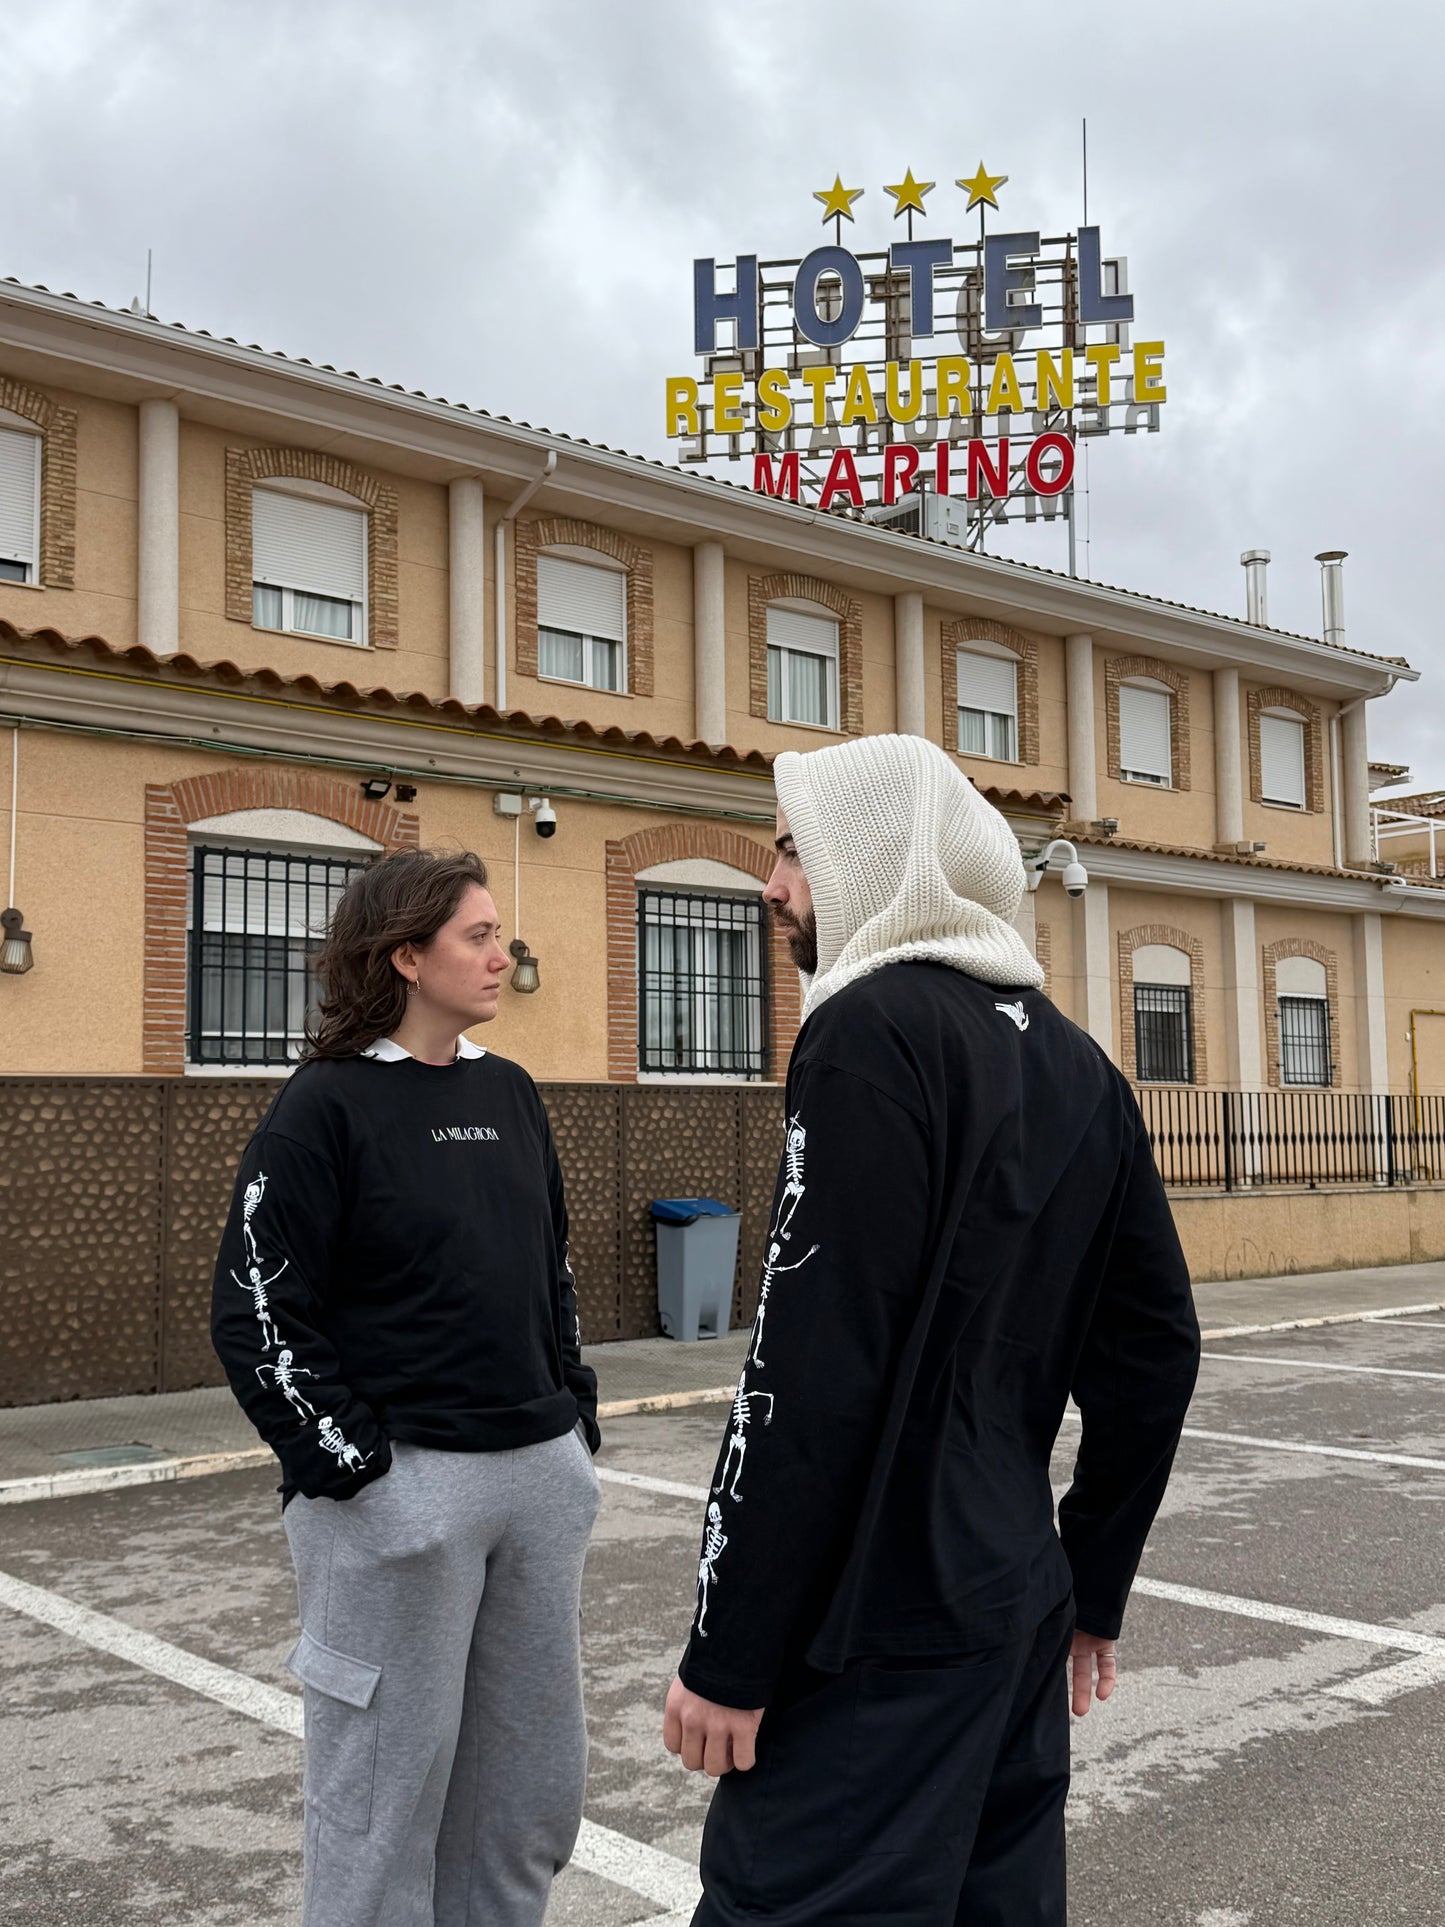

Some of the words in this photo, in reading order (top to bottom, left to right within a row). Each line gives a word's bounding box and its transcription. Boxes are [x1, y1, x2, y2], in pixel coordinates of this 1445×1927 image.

[693, 225, 1134, 356] HOTEL
[665, 341, 1166, 438] RESTAURANTE
[753, 432, 1075, 510] MARINO
[431, 1128, 448, 1142] LA
[446, 1126, 500, 1141] MILAGROSA
